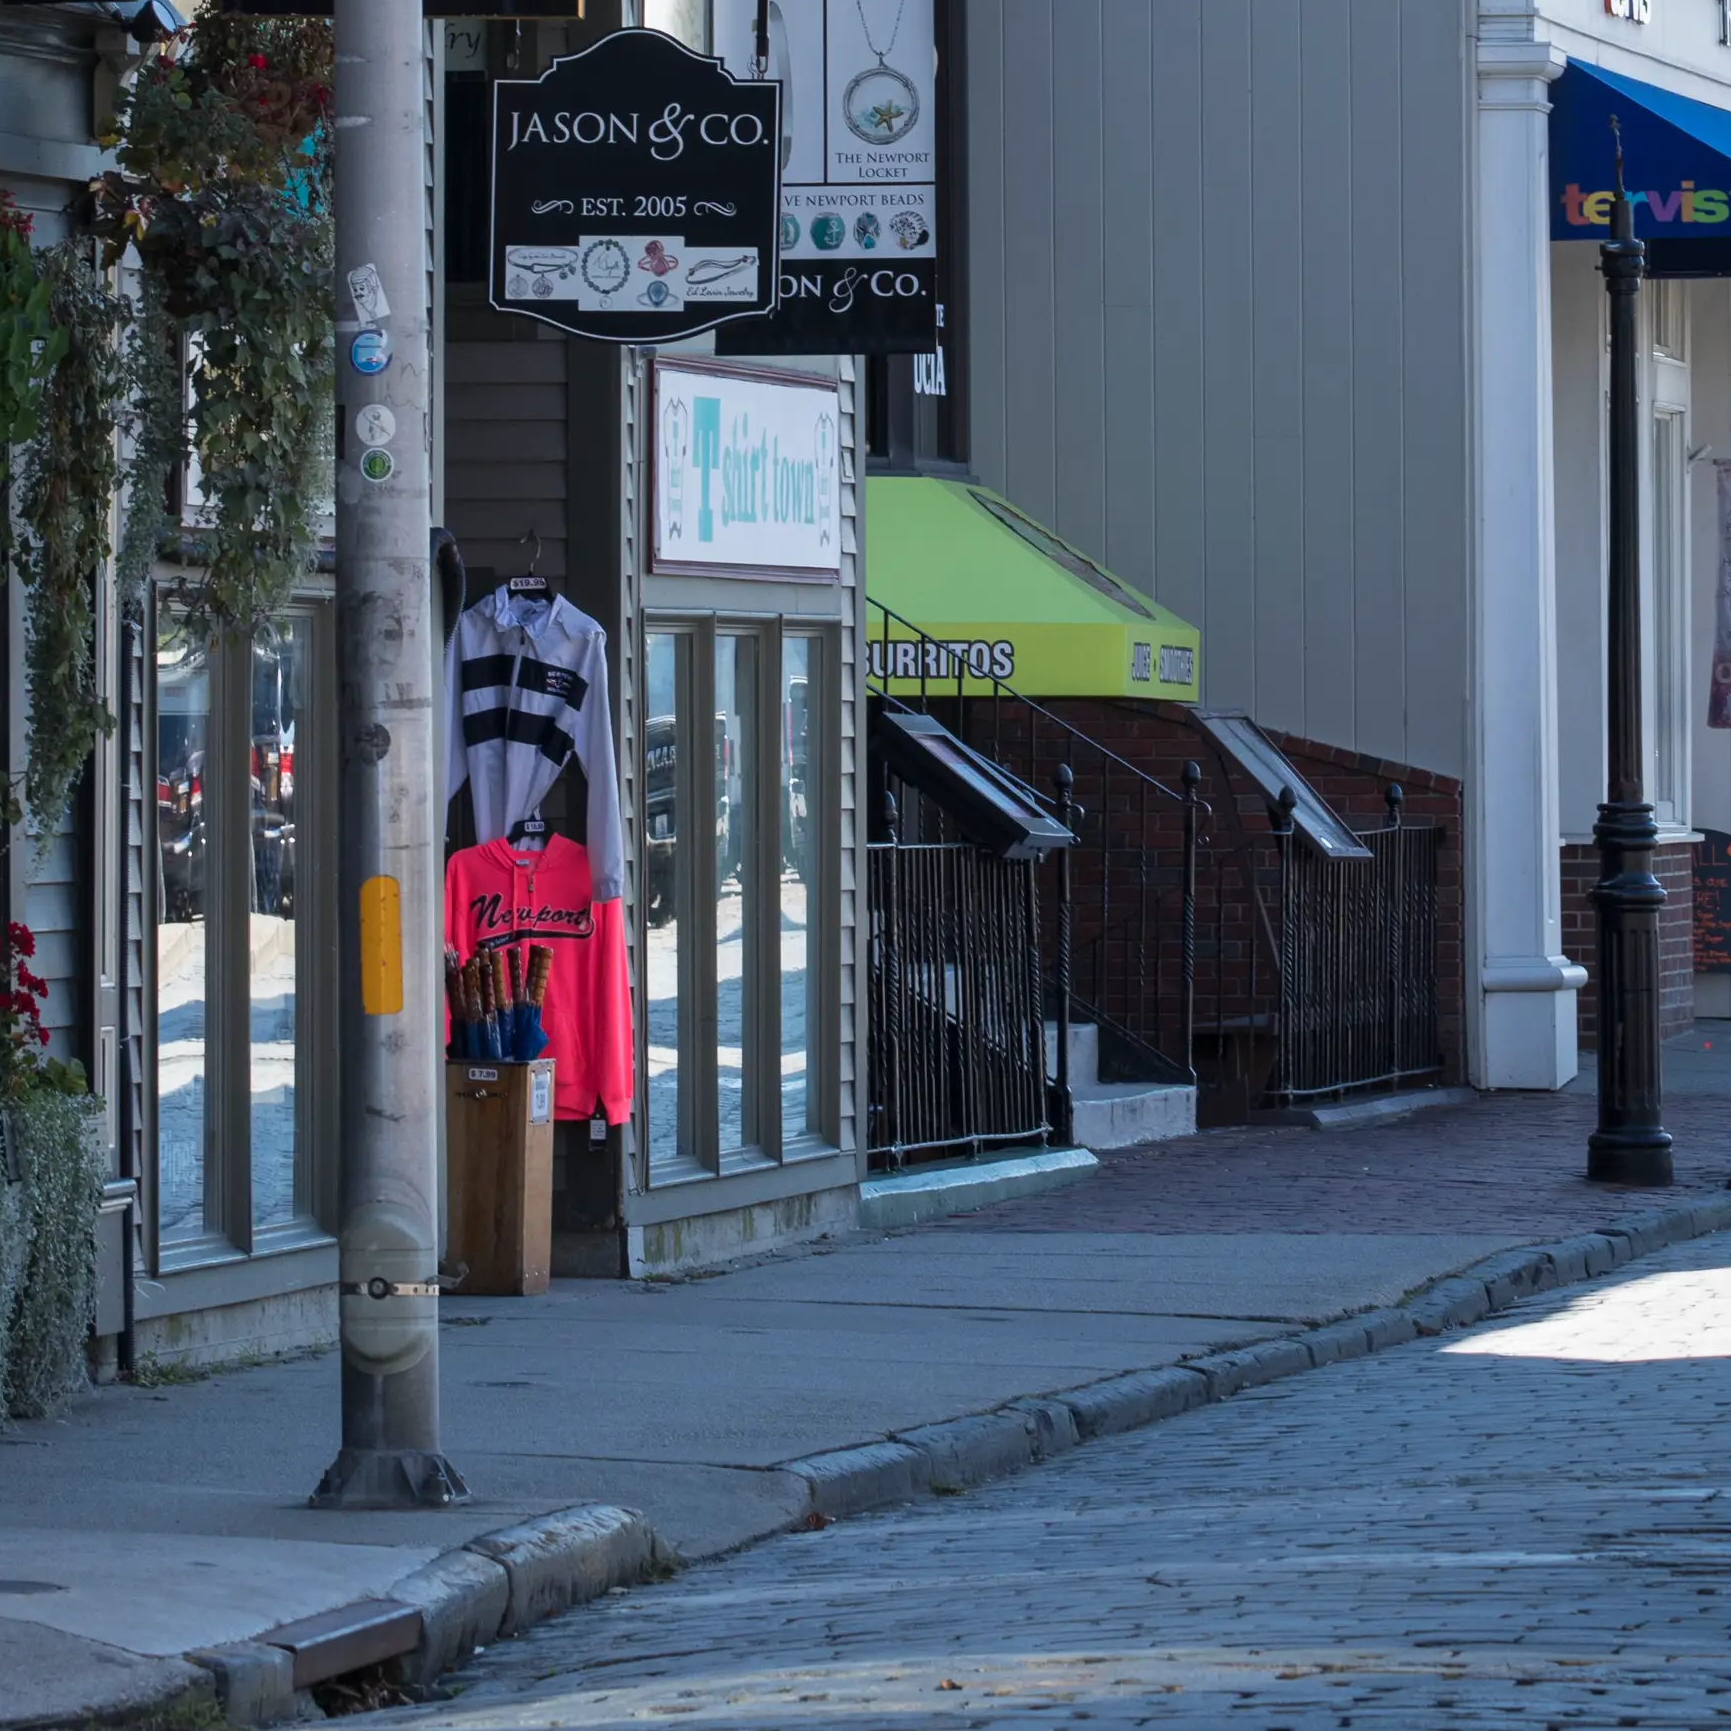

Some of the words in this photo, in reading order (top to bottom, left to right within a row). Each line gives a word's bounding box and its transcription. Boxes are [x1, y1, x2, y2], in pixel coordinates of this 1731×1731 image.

[508, 112, 639, 151] JASON
[649, 103, 695, 160] &
[700, 114, 768, 145] CO.
[836, 152, 863, 163] THE
[867, 152, 930, 163] NEWPORT
[859, 167, 908, 178] LOCKET
[581, 198, 625, 216] EST.
[634, 196, 687, 217] 2005
[806, 194, 876, 207] NEWPORT
[881, 193, 924, 205] BEADS
[1560, 180, 1731, 226] tervis
[829, 267, 868, 313] &
[693, 396, 721, 542] T
[722, 412, 769, 528] shirt
[773, 434, 815, 524] town
[470, 891, 591, 931] Newport
